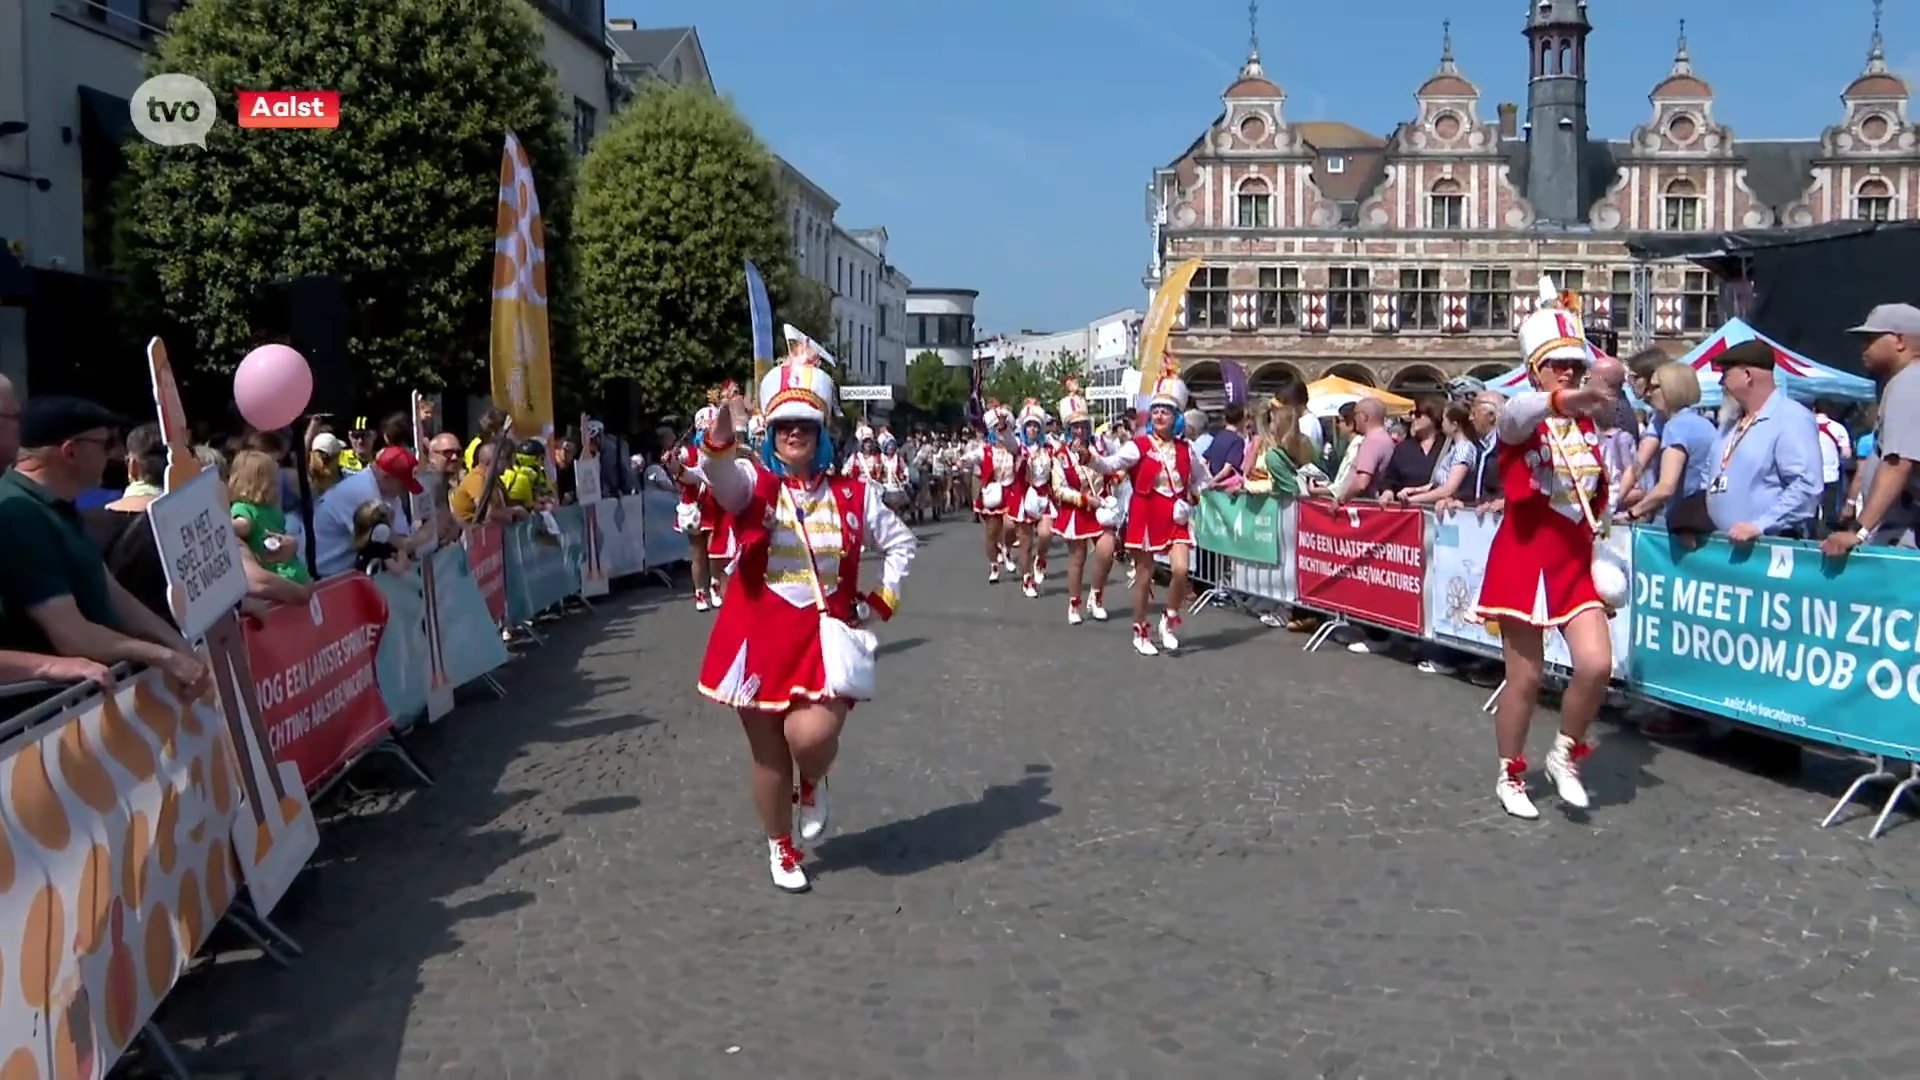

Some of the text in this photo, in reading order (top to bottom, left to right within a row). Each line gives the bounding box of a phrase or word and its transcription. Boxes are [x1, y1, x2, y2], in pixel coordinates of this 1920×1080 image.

[1317, 534, 1334, 554] EEN
[1672, 577, 1753, 624] MEET
[1761, 591, 1791, 631] IS
[1802, 596, 1837, 640] IN
[1846, 602, 1920, 653] ZIC
[285, 660, 308, 699] EEN
[1635, 613, 1660, 650] JE
[1672, 621, 1857, 690] DROOMJOB
